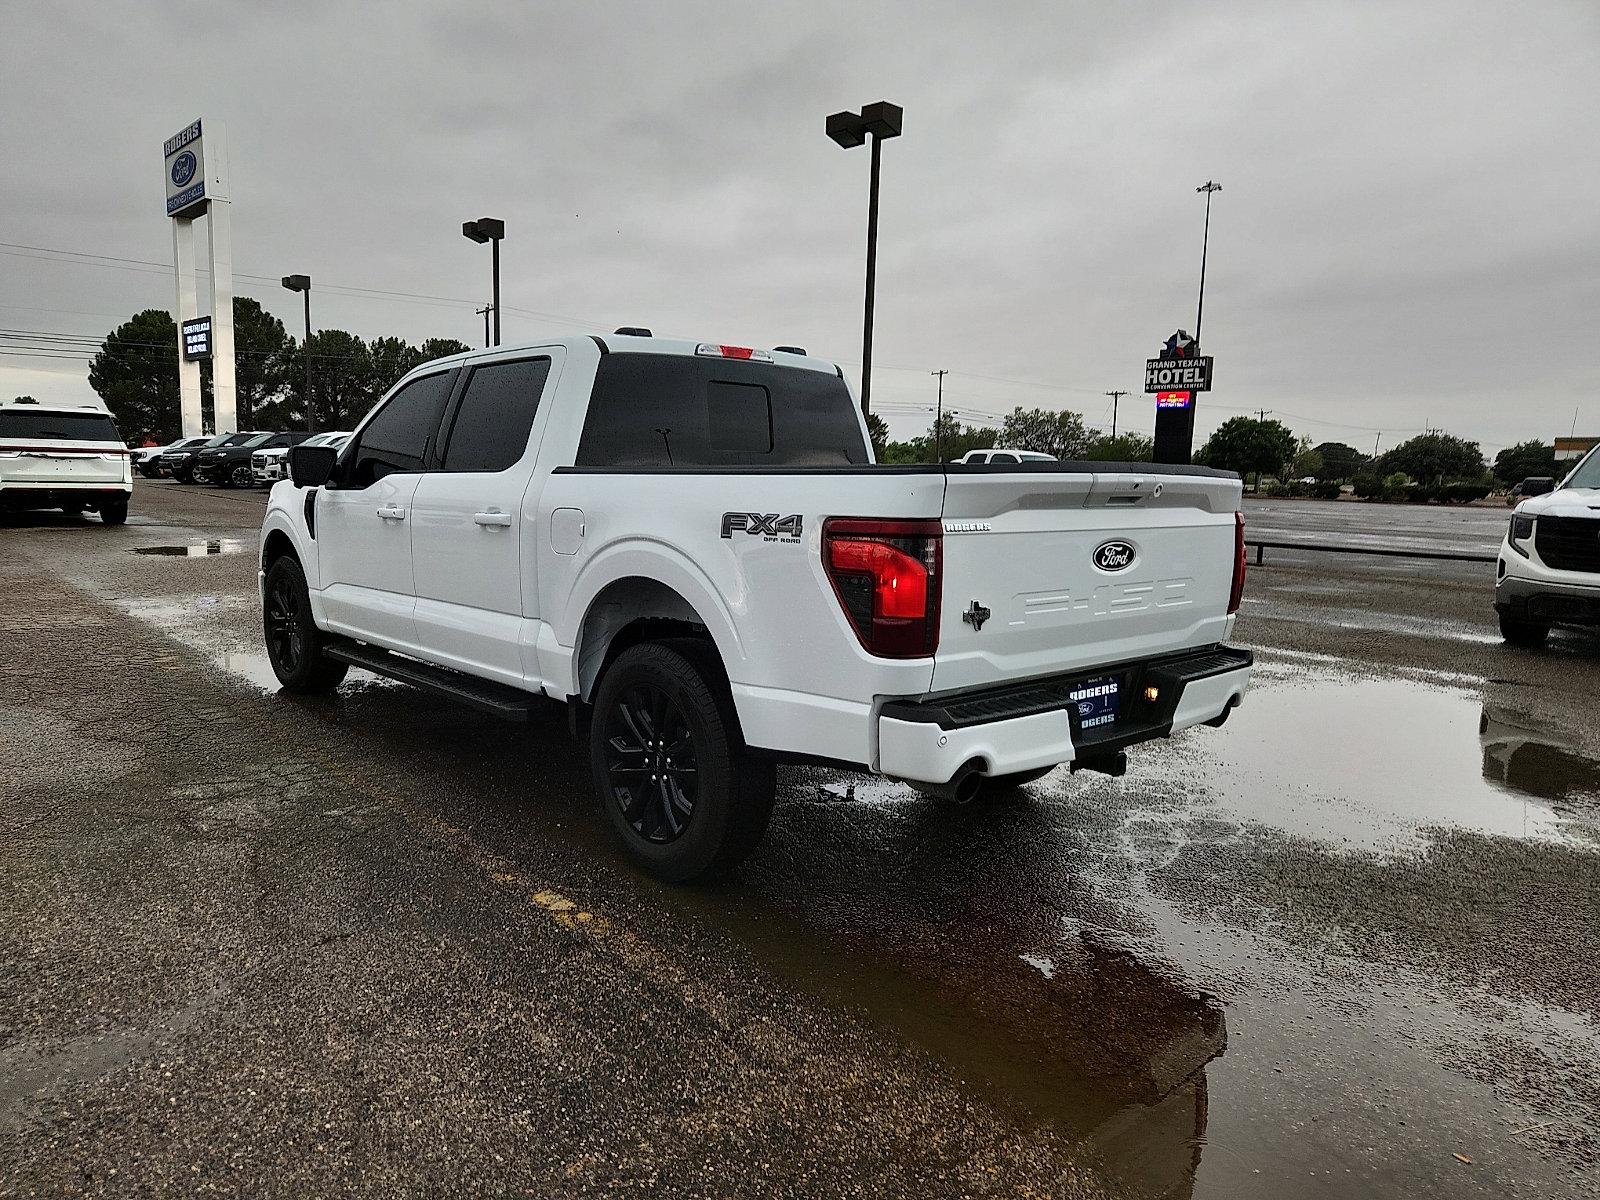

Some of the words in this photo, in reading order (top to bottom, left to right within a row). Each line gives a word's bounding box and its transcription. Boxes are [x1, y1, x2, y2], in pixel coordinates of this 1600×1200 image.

[165, 123, 200, 156] ROGERS
[1147, 360, 1177, 370] GRAND
[1177, 358, 1206, 368] TEXAN
[1145, 367, 1204, 385] HOTEL
[1150, 383, 1183, 391] CONVENTION
[720, 511, 803, 539] FX4
[1101, 545, 1130, 566] Ford
[1008, 577, 1195, 626] F-150
[1069, 682, 1118, 701] ROGERS
[1081, 713, 1115, 729] OGERS
